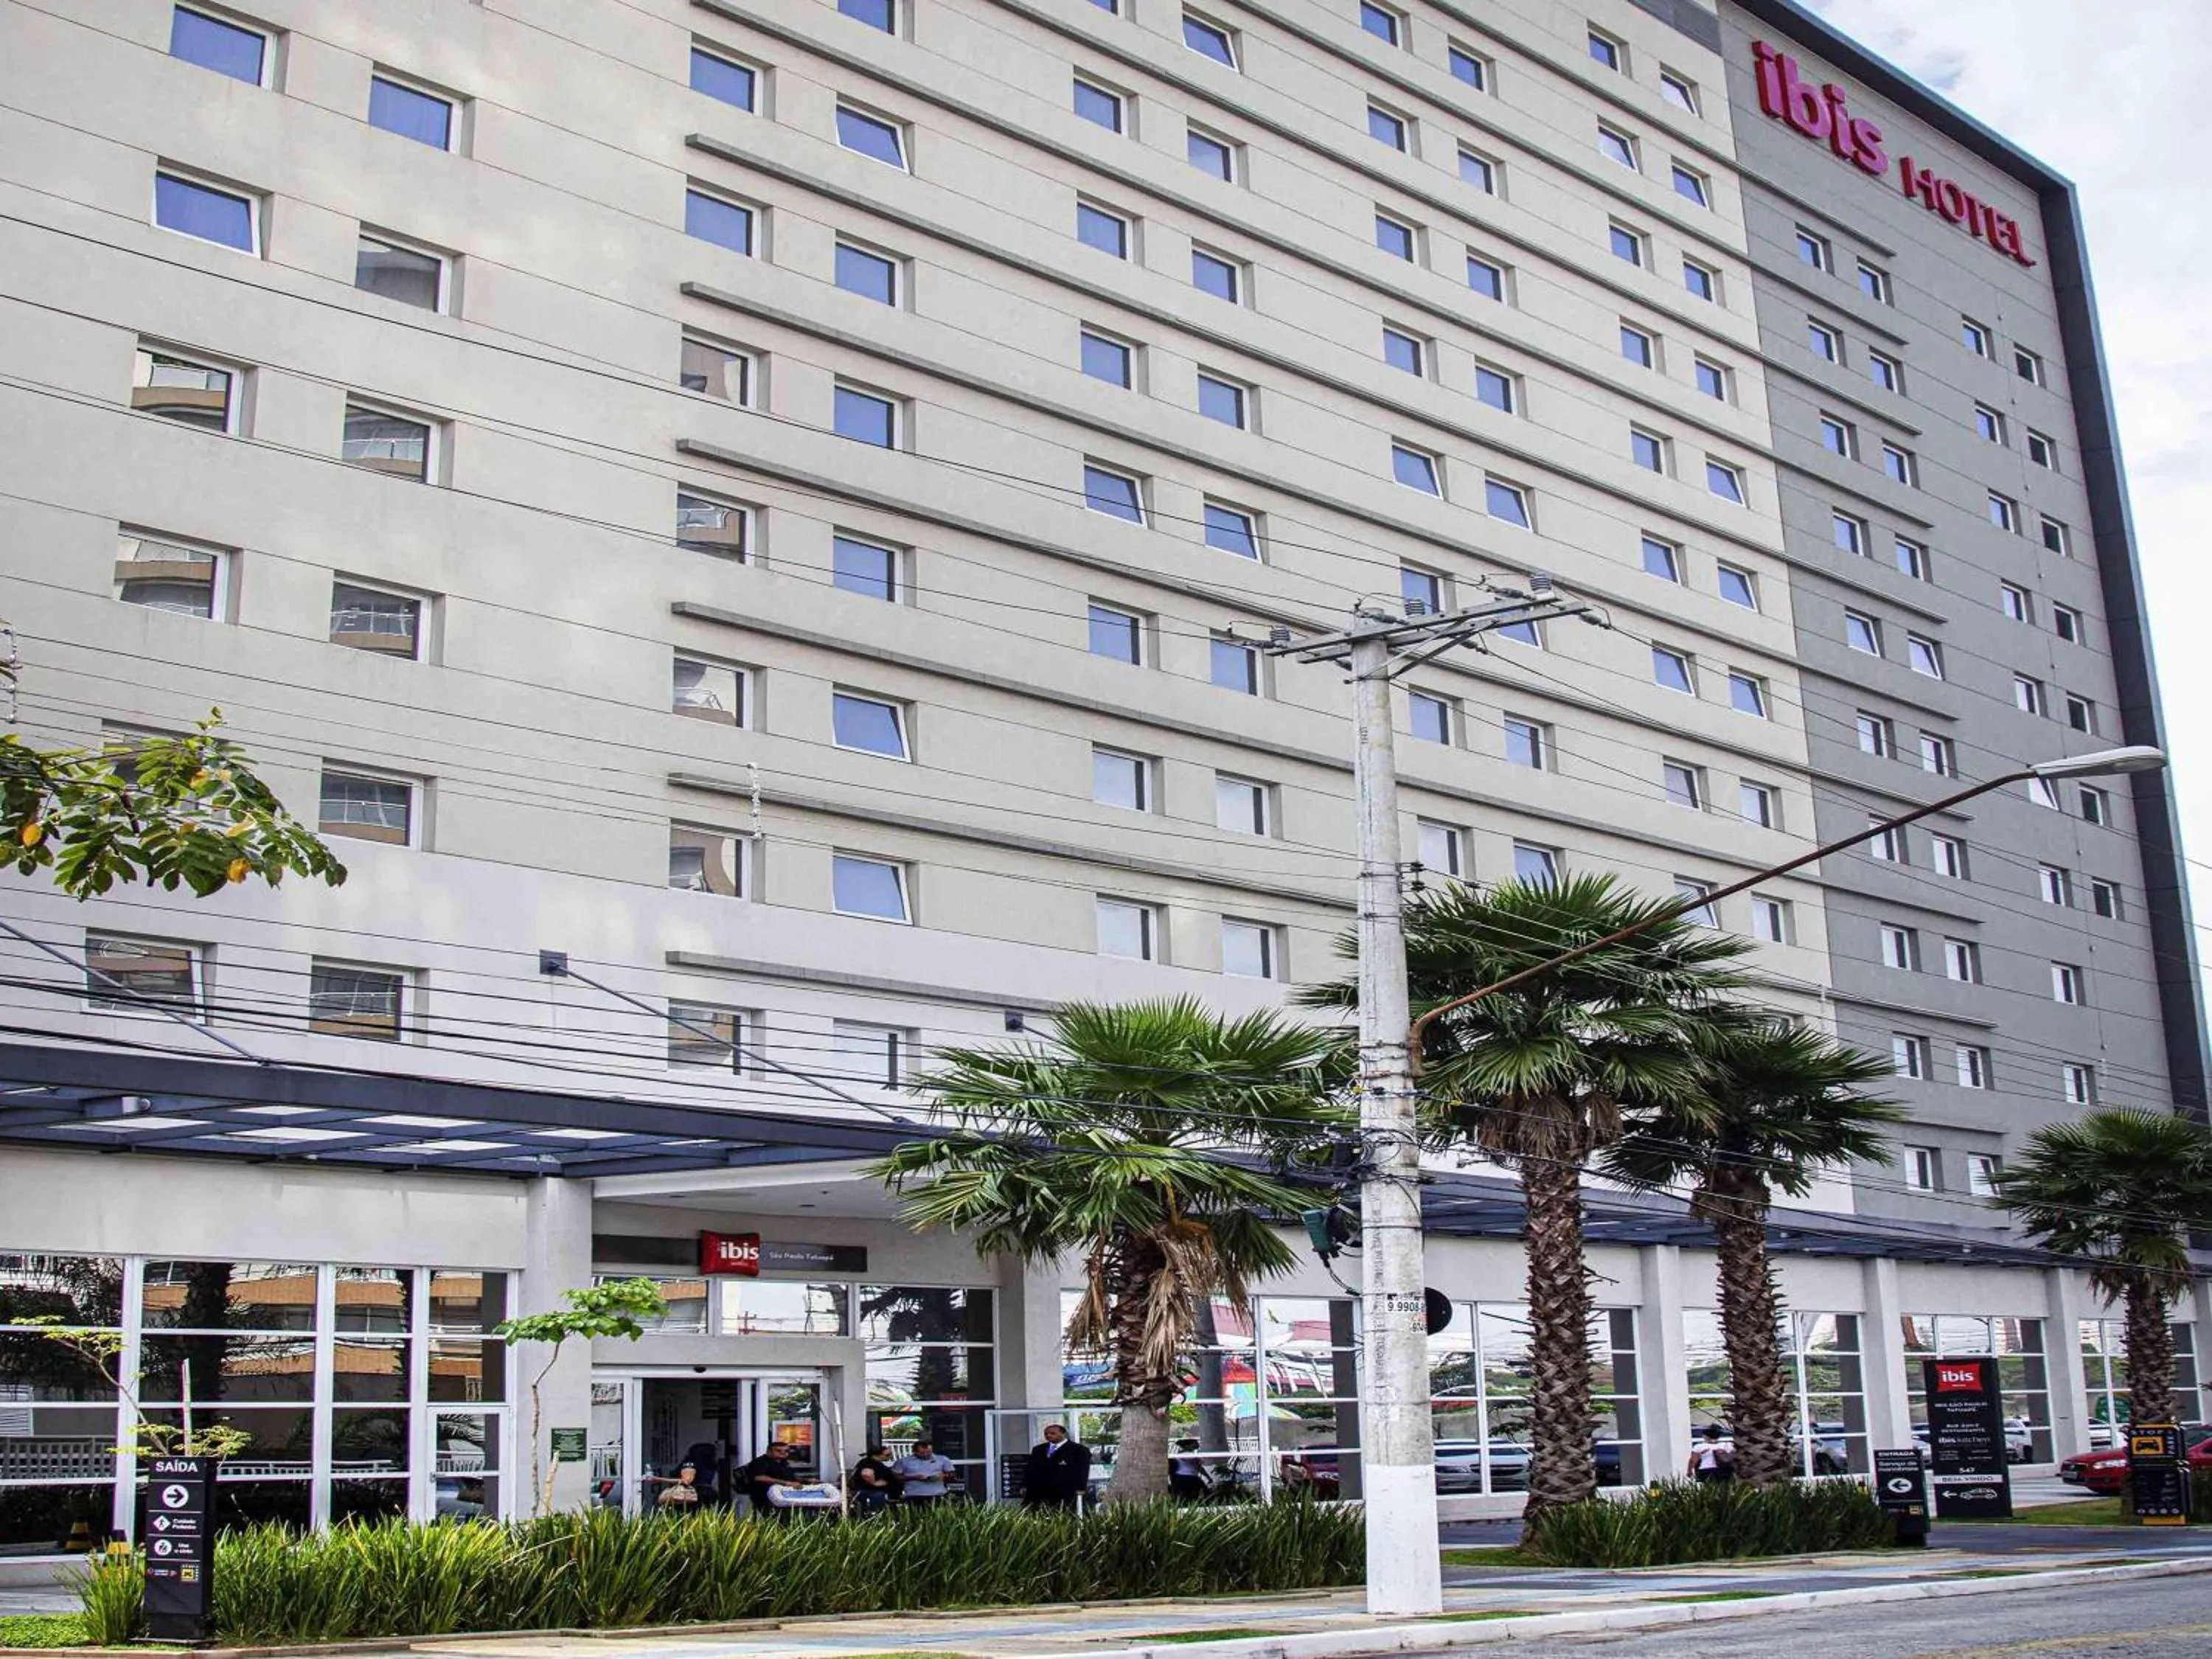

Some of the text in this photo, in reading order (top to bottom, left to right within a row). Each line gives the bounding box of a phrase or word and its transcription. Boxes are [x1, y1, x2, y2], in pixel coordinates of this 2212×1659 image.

[1752, 40, 2037, 268] ibis HOTEL
[720, 1242, 759, 1260] ibis
[1941, 1369, 1974, 1382] ibis
[156, 1458, 198, 1472] SAÍDA
